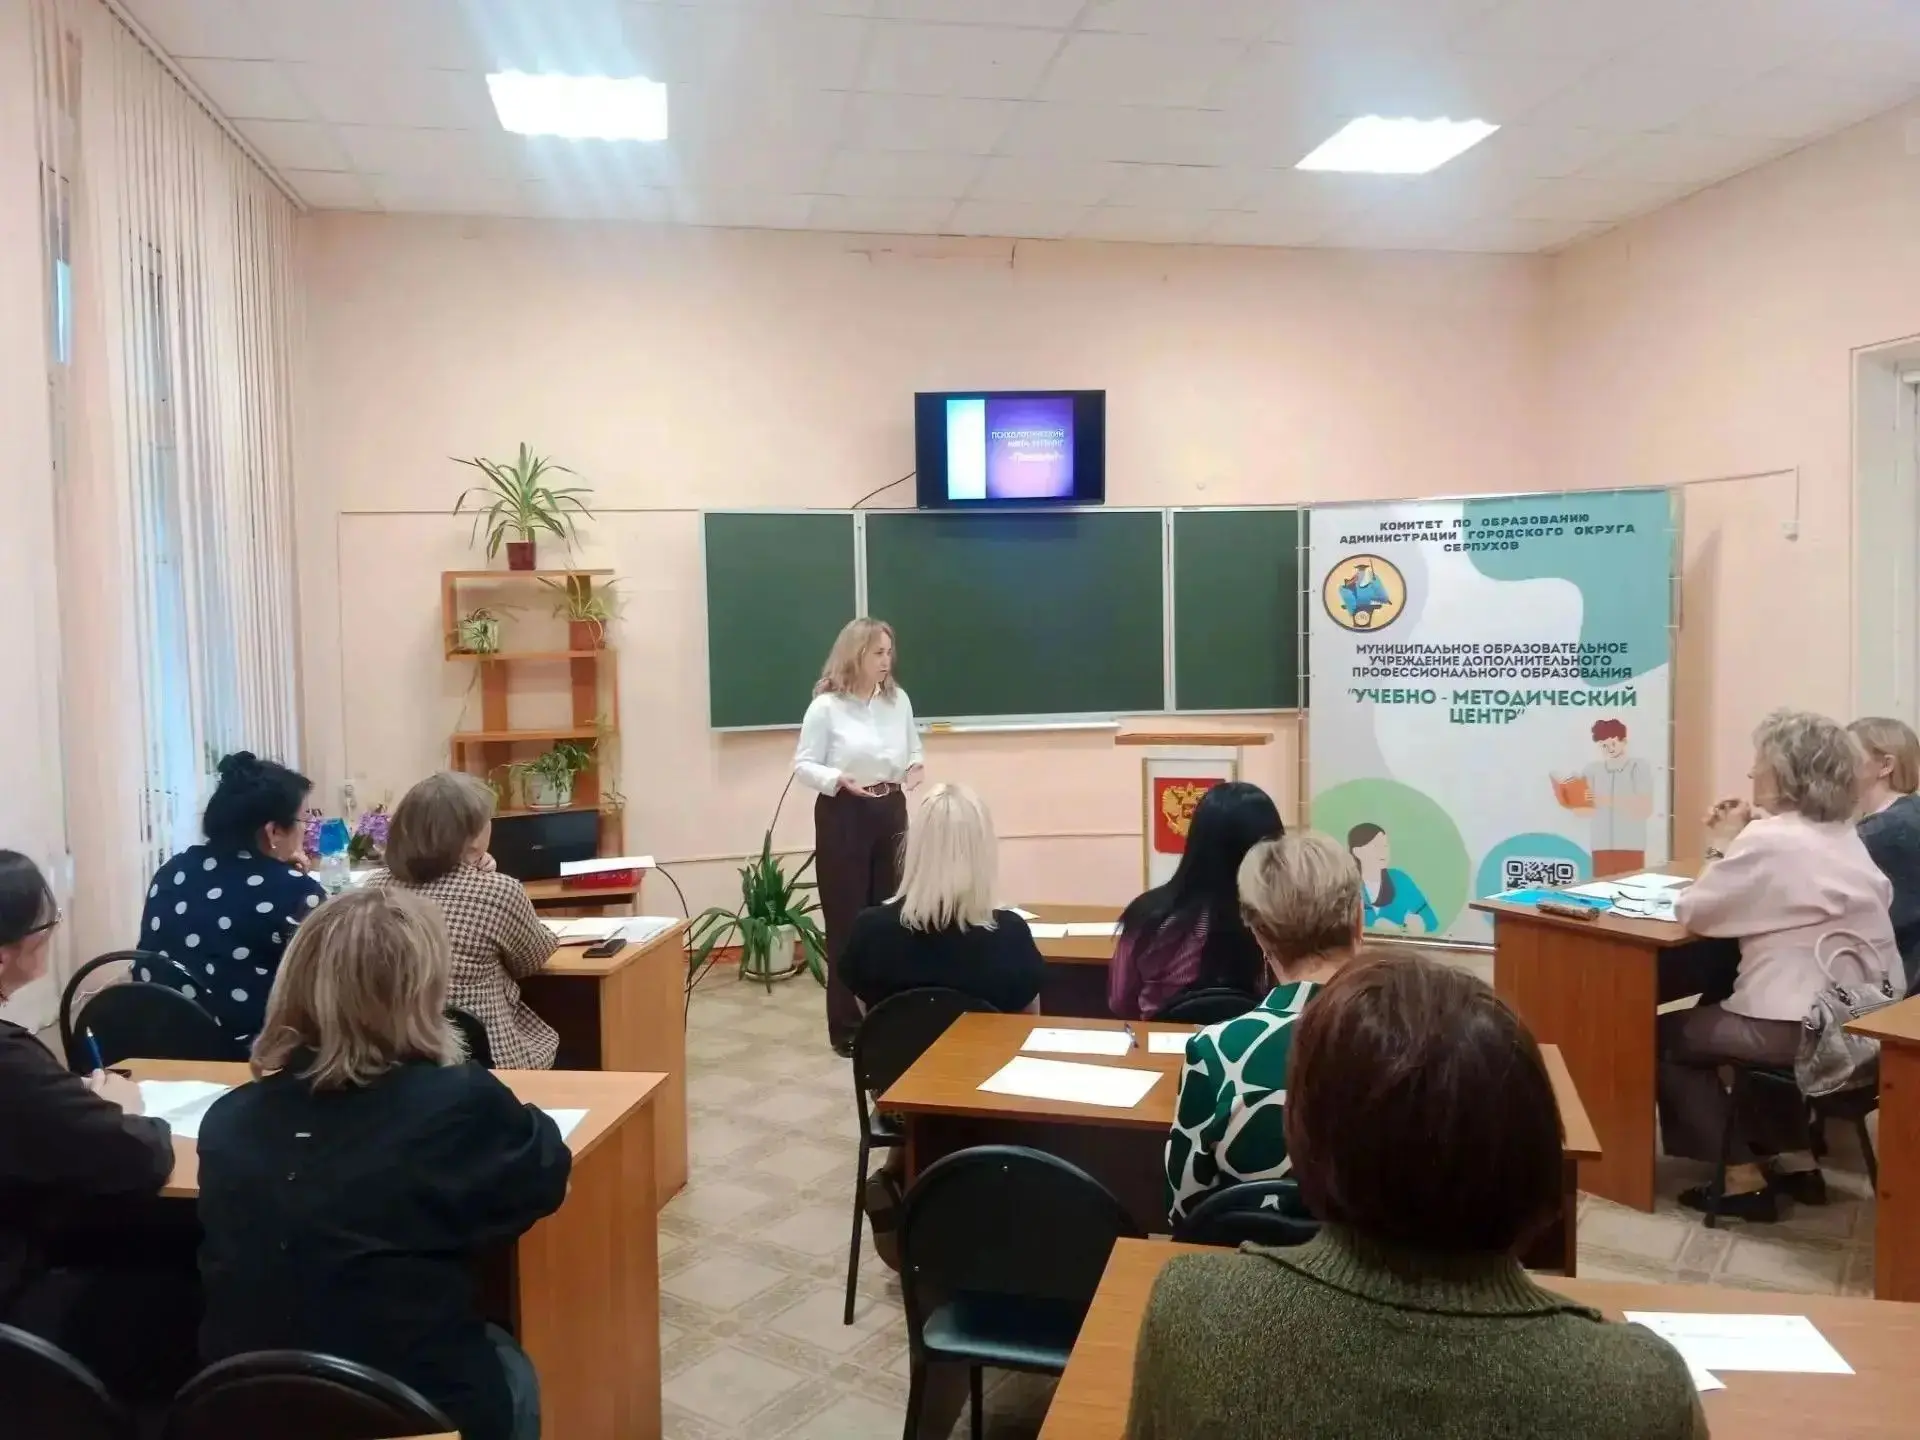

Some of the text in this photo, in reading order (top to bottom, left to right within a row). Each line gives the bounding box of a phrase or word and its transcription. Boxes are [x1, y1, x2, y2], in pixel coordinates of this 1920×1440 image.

[1380, 513, 1590, 531] КОМИТЕТ ПО ОБРАЗОВАНИЮ
[1340, 524, 1636, 544] АДМИНИСТРАЦИИ ГОРОДСКОГО ОКРУГА
[1443, 541, 1519, 552] СЕРПУХОВ
[1356, 642, 1628, 655] МУНИЦИПАЛЬНОЕ ОБРАЗОВАТЕЛЬНОЕ
[1369, 655, 1612, 666] УЧРЕЖДЕНИЕ ДОПОЛНИТЕЛЬНОГО
[1352, 667, 1632, 678] ПРОФЕССИОНАЛЬНОГО ОБРАЗОВАНИЯ
[1347, 687, 1437, 704] "УЧЕБНО
[1453, 685, 1637, 706] МЕТОДИЧЕСКИЙ
[1449, 708, 1525, 725] ЦЕНТР"
